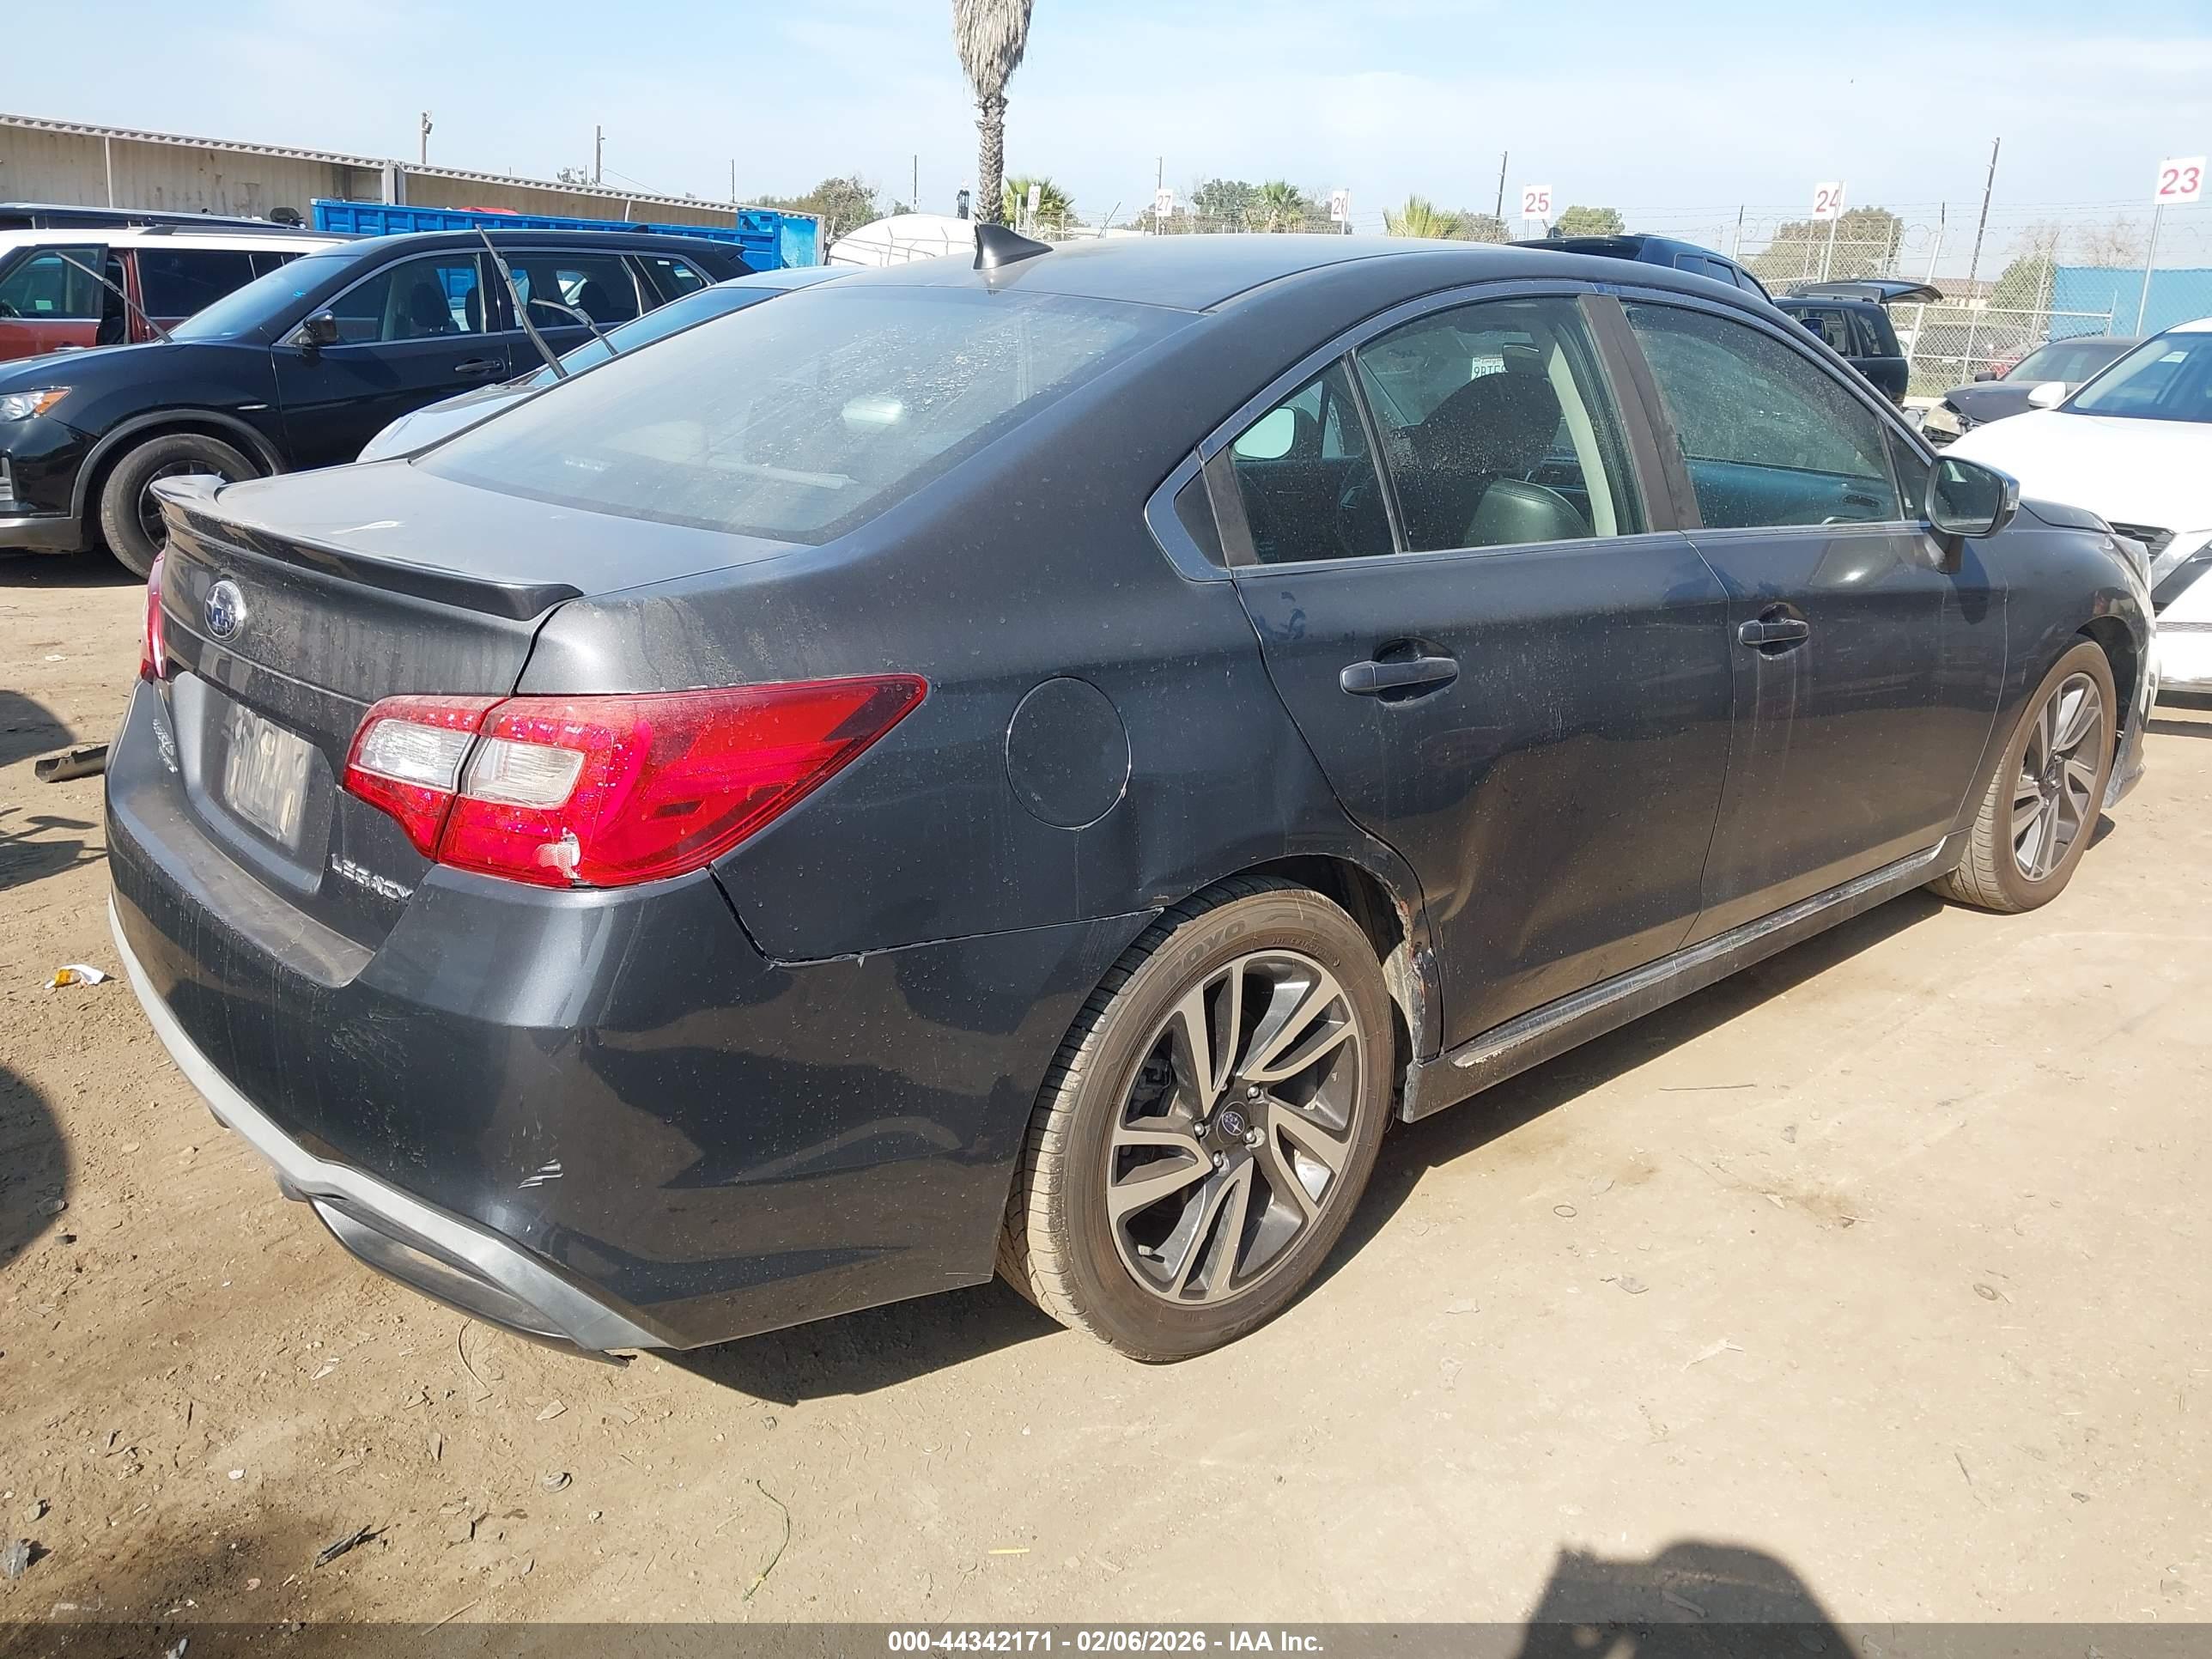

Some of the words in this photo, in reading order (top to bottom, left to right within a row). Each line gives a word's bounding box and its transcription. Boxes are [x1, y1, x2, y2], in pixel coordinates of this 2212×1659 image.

[2160, 167, 2199, 195] 23
[1157, 195, 1171, 211] 27
[1524, 192, 1549, 212] 25
[1815, 189, 1840, 212] 24
[331, 853, 415, 900] LEGACY
